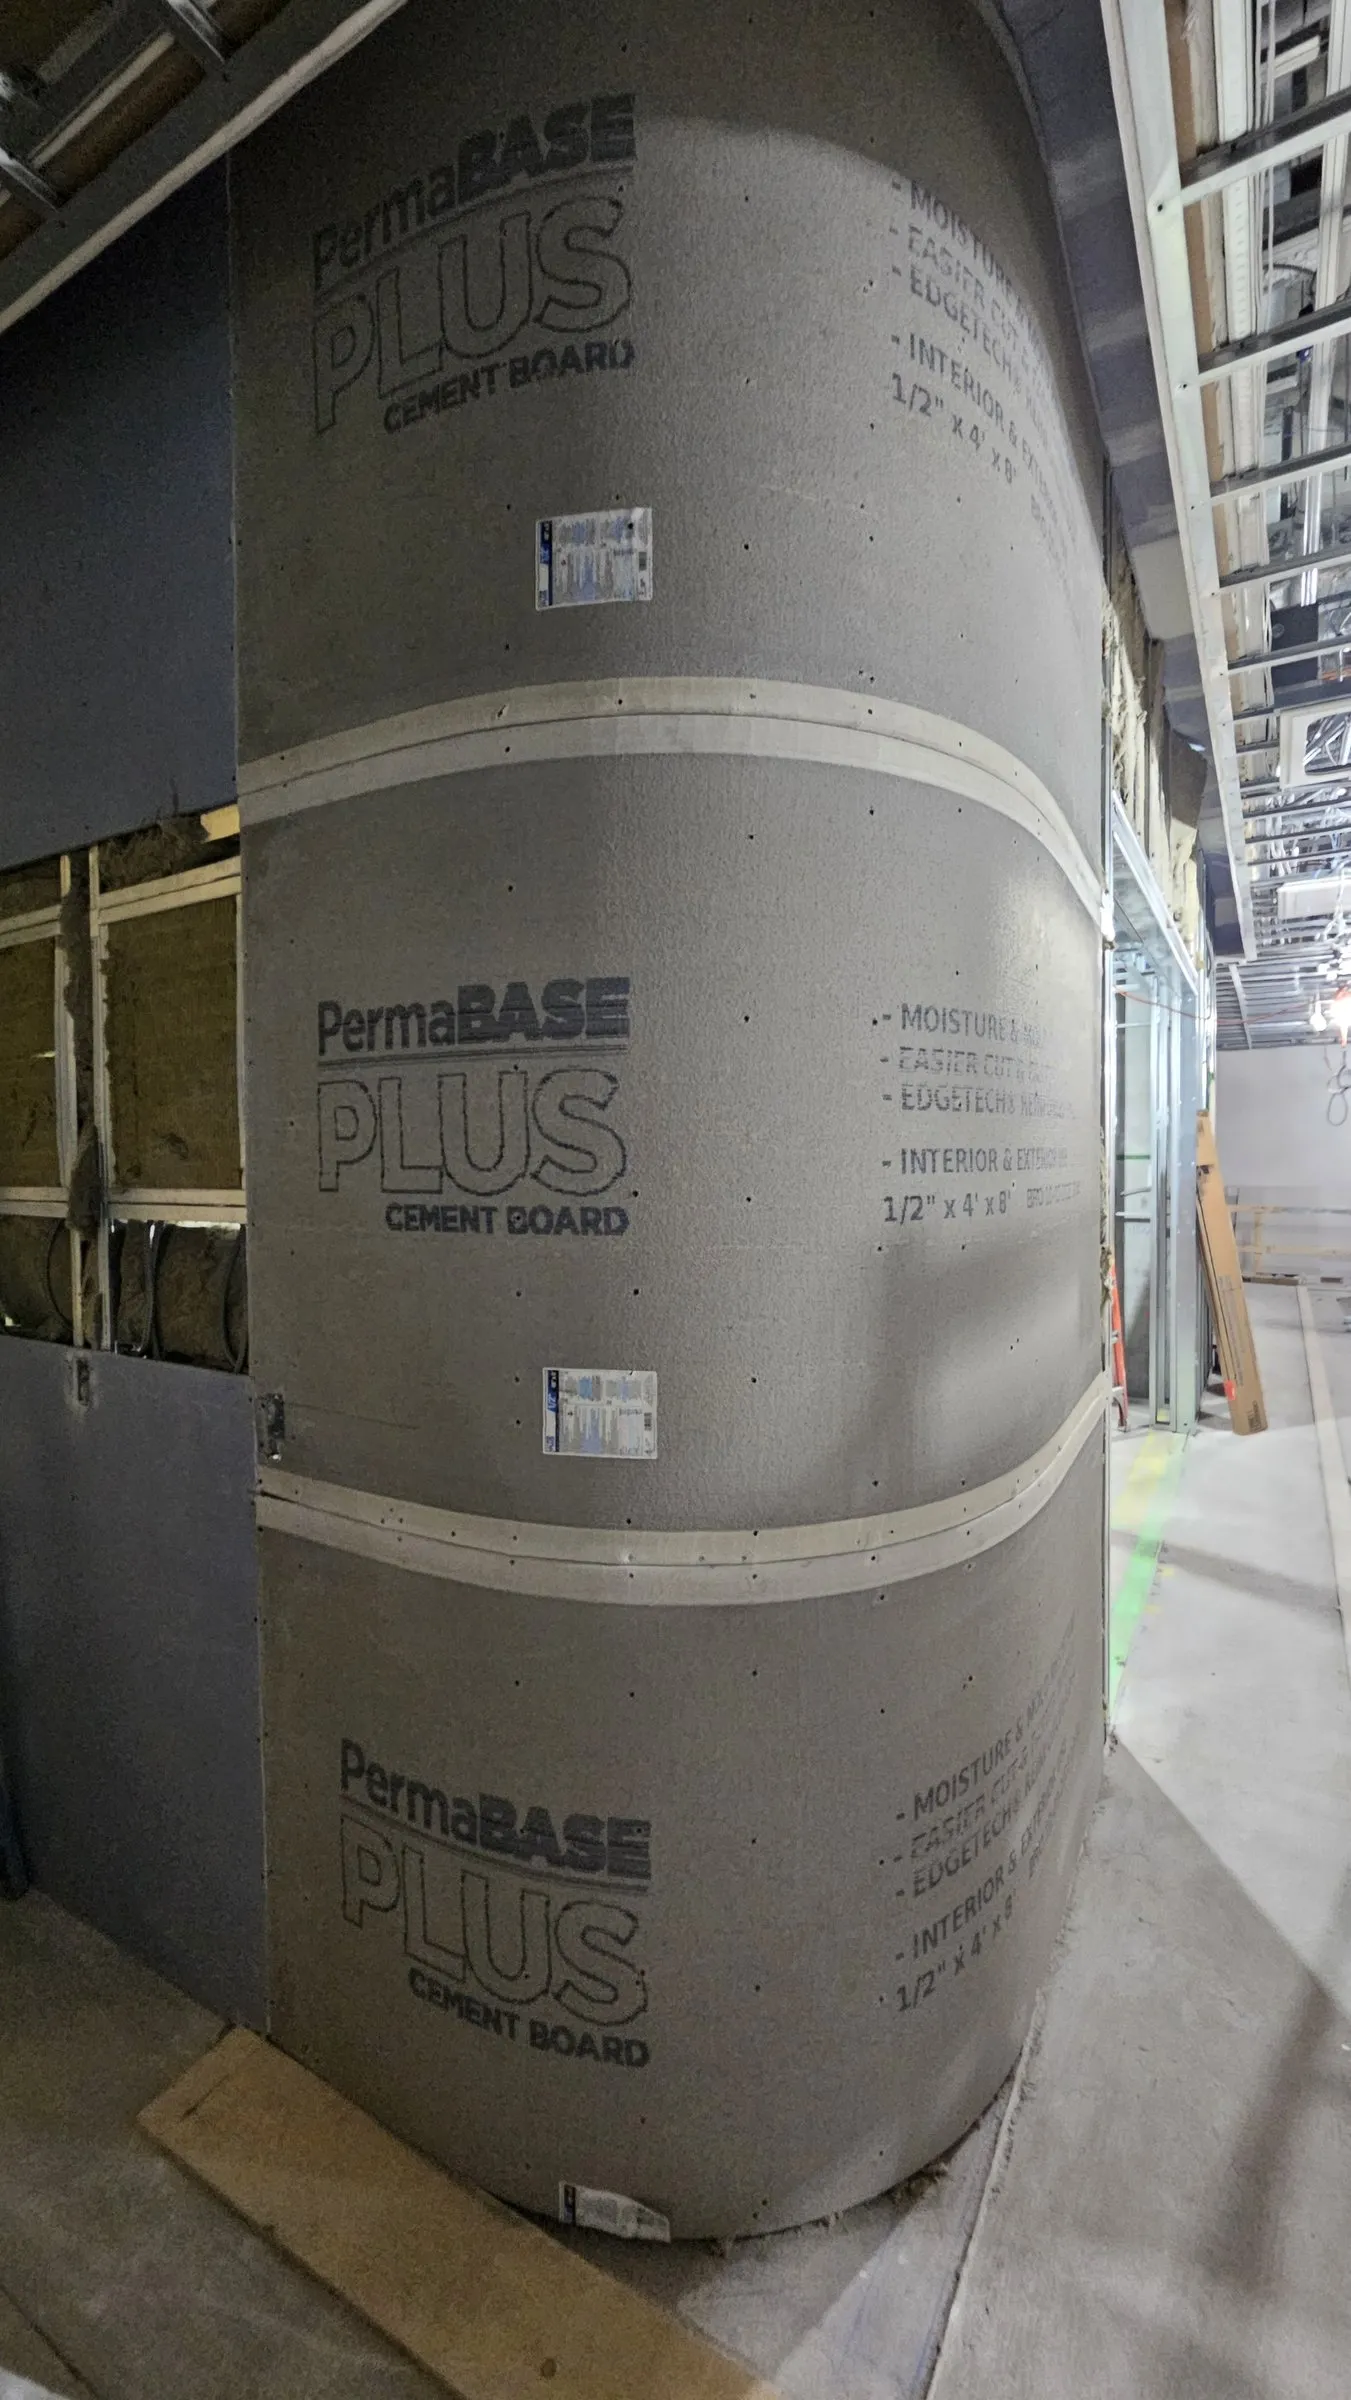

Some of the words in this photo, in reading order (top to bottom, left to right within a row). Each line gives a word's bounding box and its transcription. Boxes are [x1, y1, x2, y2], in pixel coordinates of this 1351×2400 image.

[908, 223, 985, 309] EASIER
[312, 196, 632, 435] PLUS
[384, 362, 506, 434] CEMENT
[510, 340, 635, 388] BOARD
[892, 373, 944, 418] 1/2"
[910, 332, 1005, 433] INTERIOR
[1009, 420, 1018, 449] &
[317, 976, 630, 1057] PermaBASE
[901, 1003, 1005, 1042] MOISTURE
[899, 1046, 978, 1075] EASIER
[317, 1068, 628, 1197] PLUS
[900, 1148, 998, 1175] INTERIOR
[1003, 1151, 1012, 1171] &
[385, 1202, 498, 1235] CEMENT
[506, 1205, 630, 1236] BOARD
[884, 1195, 935, 1225] 1/2"
[340, 1737, 651, 1881] PermaBASE
[914, 1728, 1013, 1822] MOISTURE
[911, 1793, 985, 1859] EASIER
[340, 1813, 648, 2027] PLUS
[913, 1865, 1005, 1960] INTERIOR
[408, 1966, 521, 2042] CEMENT
[529, 2018, 651, 2069] BOARD
[896, 1960, 946, 2013] 1/2"
